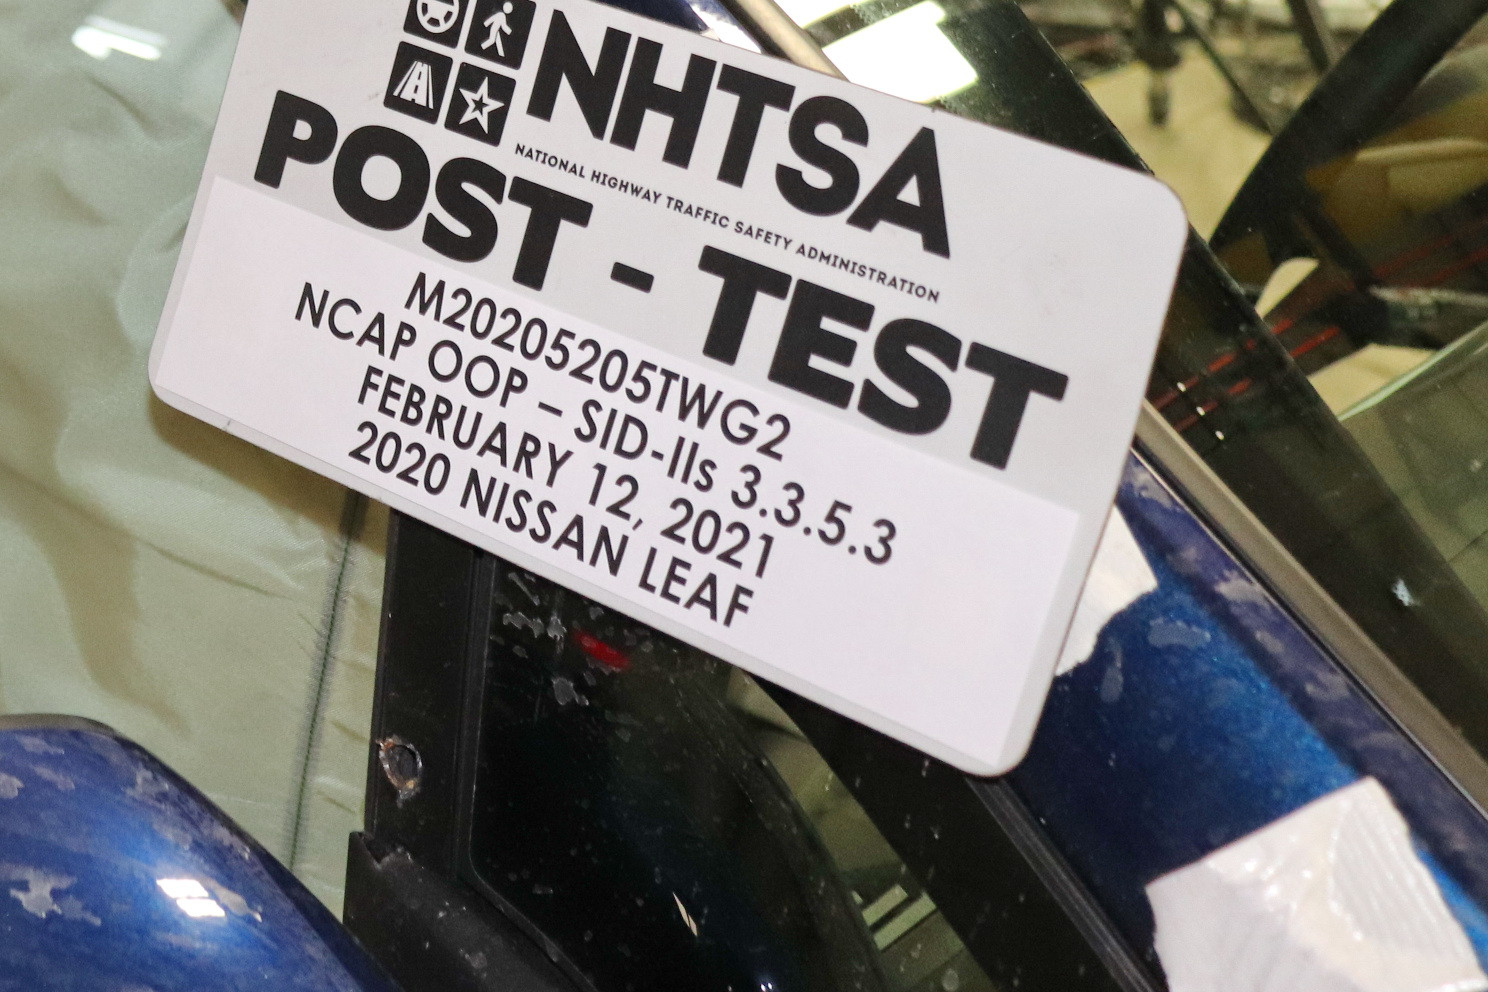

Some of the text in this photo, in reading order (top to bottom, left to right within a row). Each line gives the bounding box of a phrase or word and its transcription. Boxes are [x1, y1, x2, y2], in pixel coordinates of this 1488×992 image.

[514, 143, 941, 303] NATIONAL HIGHWAY TRAFFIC SAFETY ADMINISTRATION
[525, 8, 951, 259] NHTSA
[253, 89, 1069, 471] POST - TEST
[404, 271, 792, 463] M20205205TWG2
[293, 281, 417, 361] NCAP
[427, 339, 530, 409] OOP
[572, 399, 718, 494] SID-IIs
[730, 464, 898, 566] 3.3.5.3
[347, 420, 755, 629] 2020 NISSAN LEAF
[356, 364, 775, 580] FEBRUARY 12, 2021
